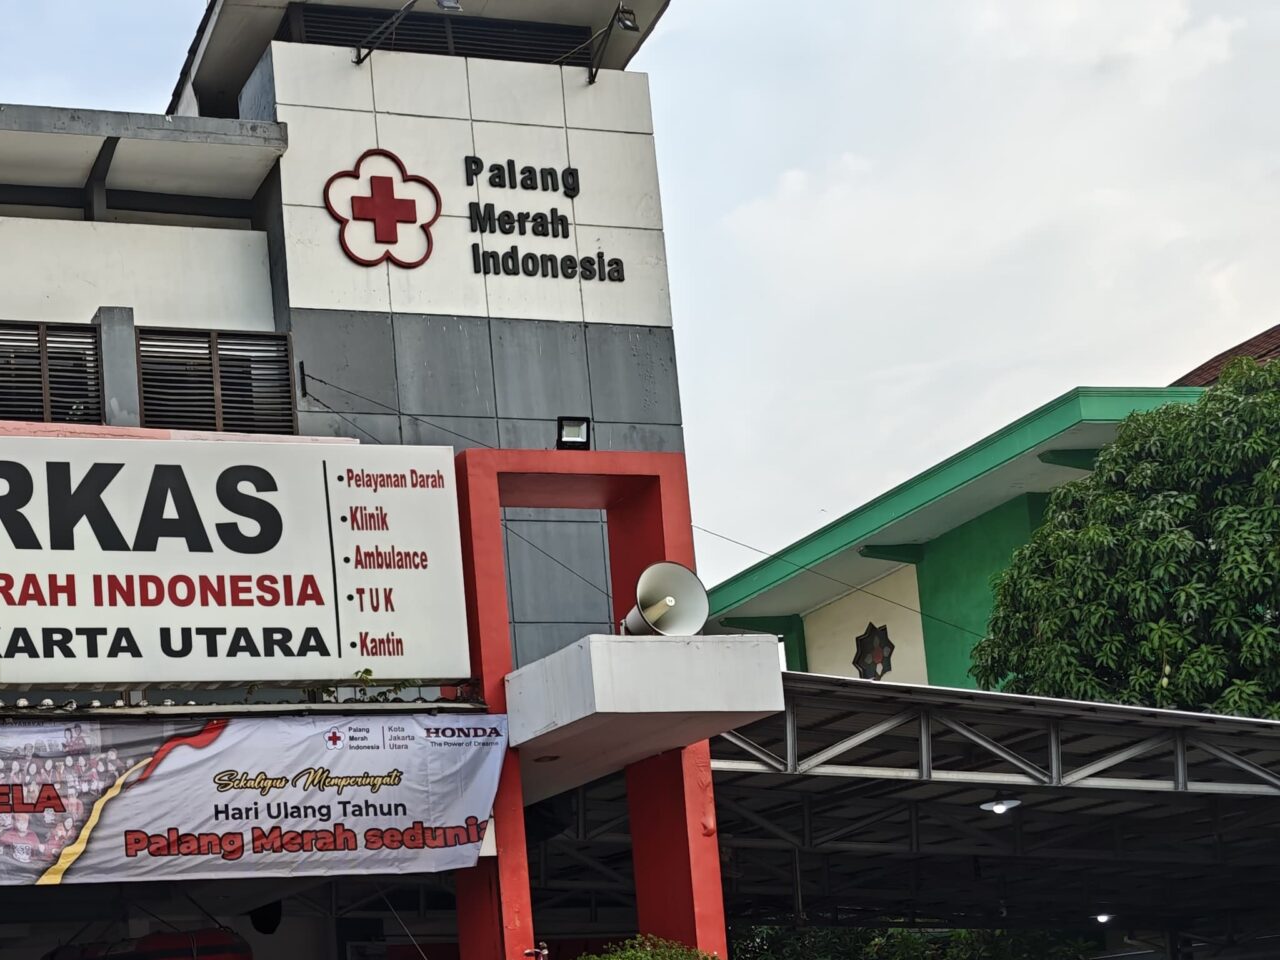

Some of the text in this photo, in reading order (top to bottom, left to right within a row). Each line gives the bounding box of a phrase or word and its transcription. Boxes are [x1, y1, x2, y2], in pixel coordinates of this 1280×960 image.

[464, 155, 581, 198] Palang
[468, 202, 570, 239] Merah
[471, 243, 625, 282] Indonesia
[346, 468, 445, 493] Pelayanan Darah
[350, 506, 390, 532] Klinik
[354, 545, 429, 570] Ambulance
[93, 574, 325, 608] INDONESIA
[160, 626, 331, 659] UTARA
[359, 631, 404, 657] Kantin
[348, 727, 370, 735] Palang
[424, 727, 503, 738] HONDA
[213, 767, 404, 797] Sekaligus Memperingati
[214, 800, 407, 825] Hari Ulang Tahun
[124, 827, 244, 861] Palang
[252, 823, 357, 856] Merah
